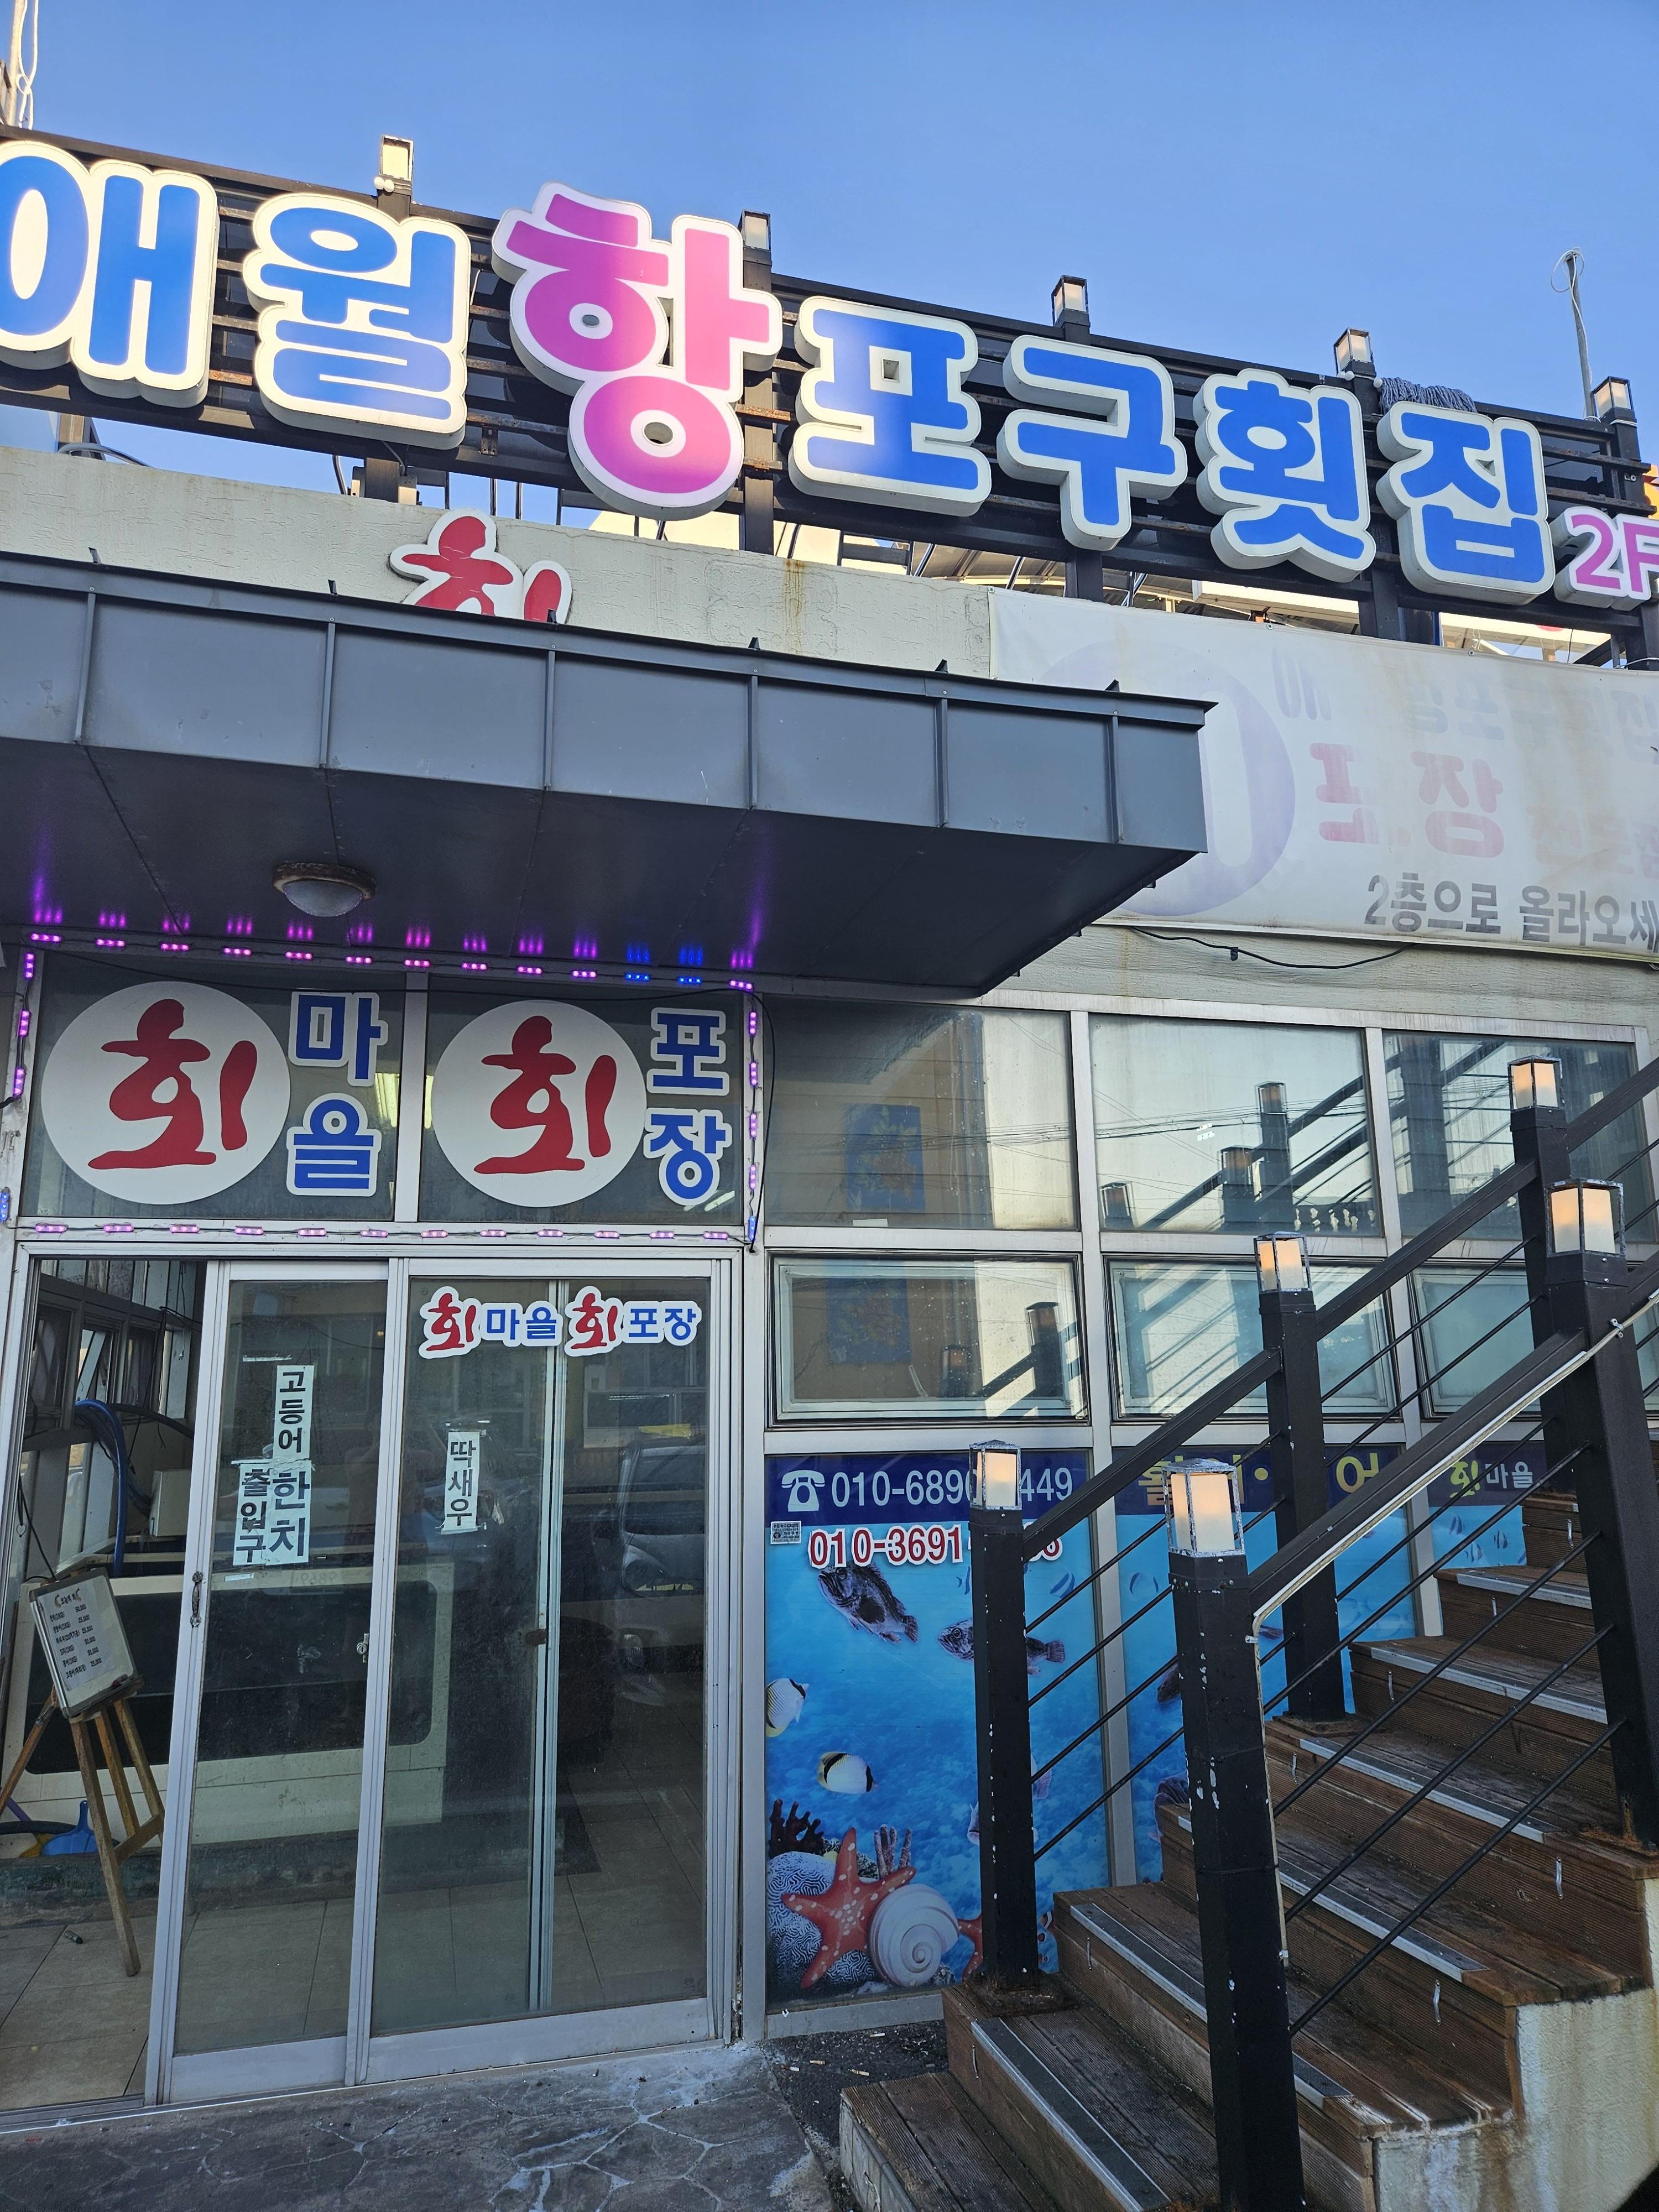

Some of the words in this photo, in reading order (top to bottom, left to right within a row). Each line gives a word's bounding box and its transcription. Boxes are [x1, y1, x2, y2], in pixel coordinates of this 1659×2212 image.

[1363, 872, 1501, 935] 2층으로
[278, 1371, 306, 1453] 고등어
[235, 1468, 271, 1563] 출입구
[269, 1470, 310, 1557] 한치
[447, 1440, 476, 1526] 딱새우
